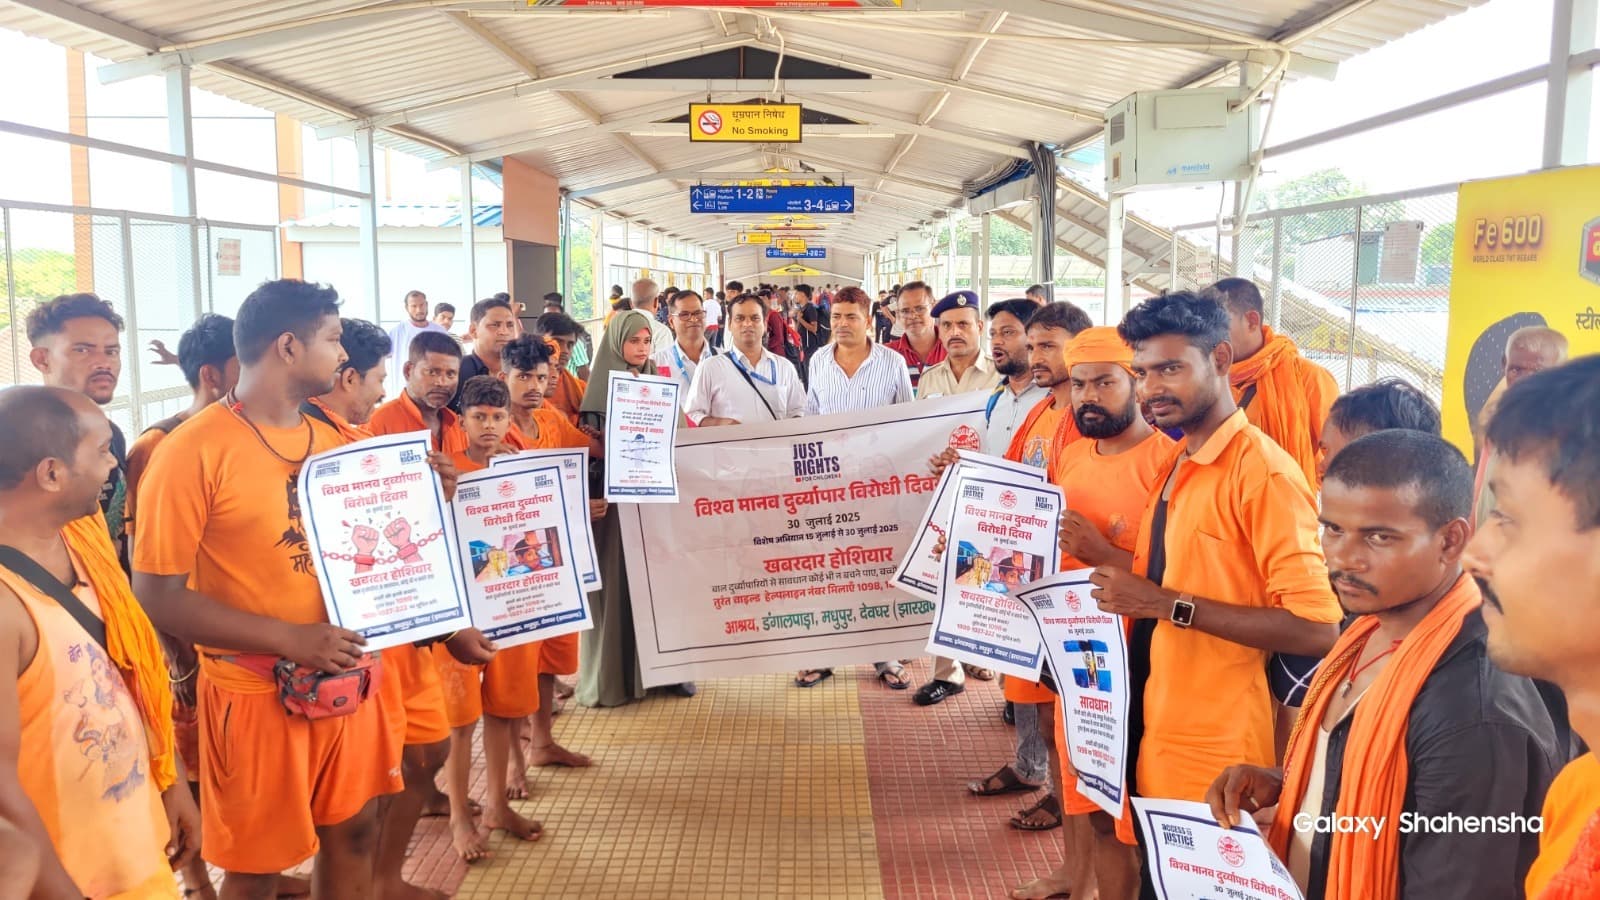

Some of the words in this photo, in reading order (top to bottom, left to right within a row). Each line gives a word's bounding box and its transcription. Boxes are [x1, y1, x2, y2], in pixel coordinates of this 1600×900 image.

[732, 127, 745, 135] No
[748, 126, 788, 137] Smoking
[736, 188, 754, 199] 1-2
[804, 199, 823, 210] 3-4
[1474, 217, 1498, 248] Fe
[1501, 214, 1543, 248] 600
[793, 441, 824, 460] JUST
[794, 456, 840, 477] RIGHTS
[321, 482, 350, 497] विश्व
[351, 478, 381, 491] मानव
[383, 471, 423, 490] दुर्व्यापार
[343, 493, 379, 510] विरोधी
[380, 489, 409, 504] दिवस
[694, 497, 735, 517] विश्व
[737, 494, 780, 512] मानव
[782, 485, 846, 515] दुर्व्यापार
[848, 475, 901, 500] विरोधी
[904, 473, 939, 495] दिव
[465, 505, 490, 517] विश्व
[491, 500, 516, 513] मानव
[517, 494, 553, 511] दुर्व्यापार
[483, 512, 514, 528] विरोधी
[515, 510, 540, 524] दिवस
[787, 519, 800, 530] 30
[805, 513, 833, 529] जुलाई
[835, 511, 861, 524] 2025
[965, 504, 987, 516] विश्व
[988, 510, 1013, 522] मानव
[1014, 513, 1048, 529] दुर्व्यापार
[845, 527, 856, 536] 30
[857, 523, 878, 538] जुलाई
[879, 523, 899, 533] 2025
[977, 521, 1007, 537] विरोधी
[1008, 527, 1033, 541] दिवस
[763, 553, 826, 574] खबरदार
[828, 545, 894, 569] होशियार
[808, 571, 824, 583] कोई
[825, 570, 834, 580] भी
[836, 571, 843, 579] न
[713, 595, 731, 609] तुरंत
[821, 608, 857, 630] मधुपुर,
[859, 602, 890, 620] देवघर
[1161, 823, 1186, 836] ACCESS
[1163, 832, 1194, 846] JUSTICE
[1169, 857, 1190, 873] विश्व
[1191, 864, 1215, 878] मानव
[1216, 870, 1249, 887] दुर्व्यापार
[1250, 877, 1277, 897] विरोधी
